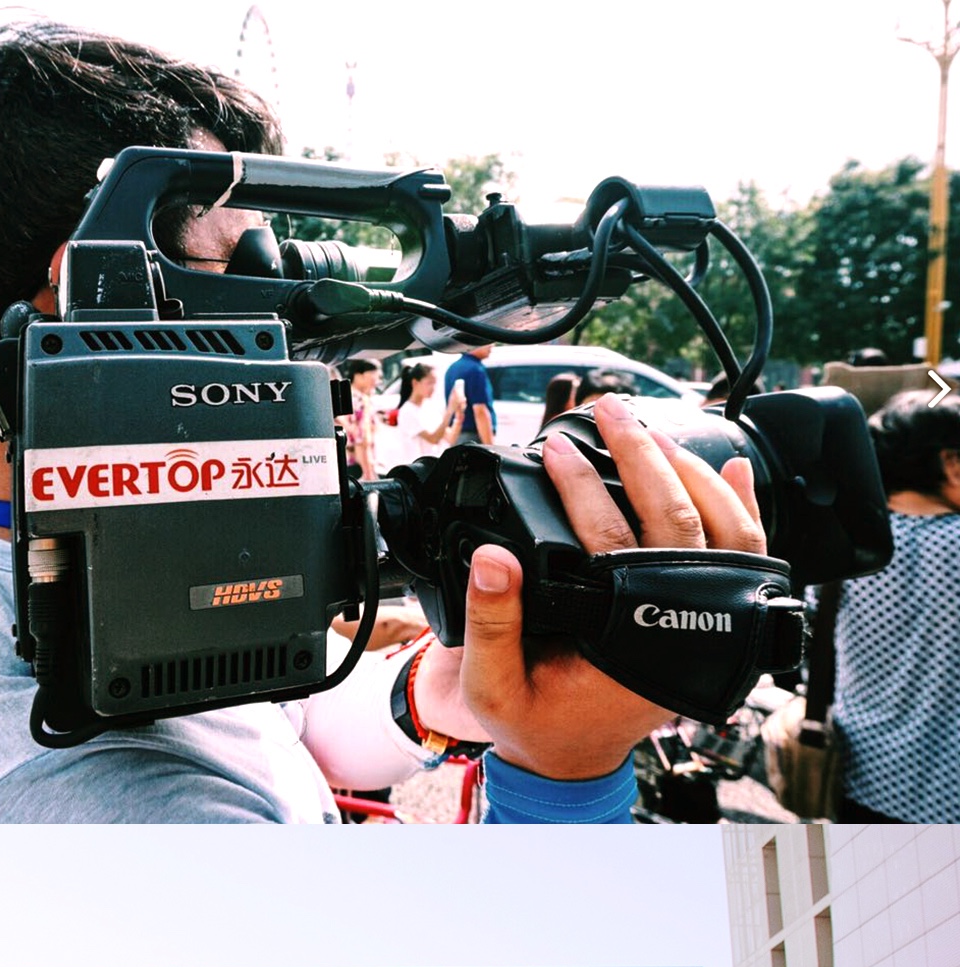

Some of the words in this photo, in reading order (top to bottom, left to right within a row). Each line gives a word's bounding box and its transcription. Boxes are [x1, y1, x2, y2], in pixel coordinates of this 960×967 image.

[171, 381, 292, 407] SONY
[31, 456, 226, 501] EVERTOP
[231, 453, 300, 490] 永达
[302, 454, 327, 464] LIVE
[212, 579, 283, 606] HDVS
[633, 603, 732, 632] Canon
